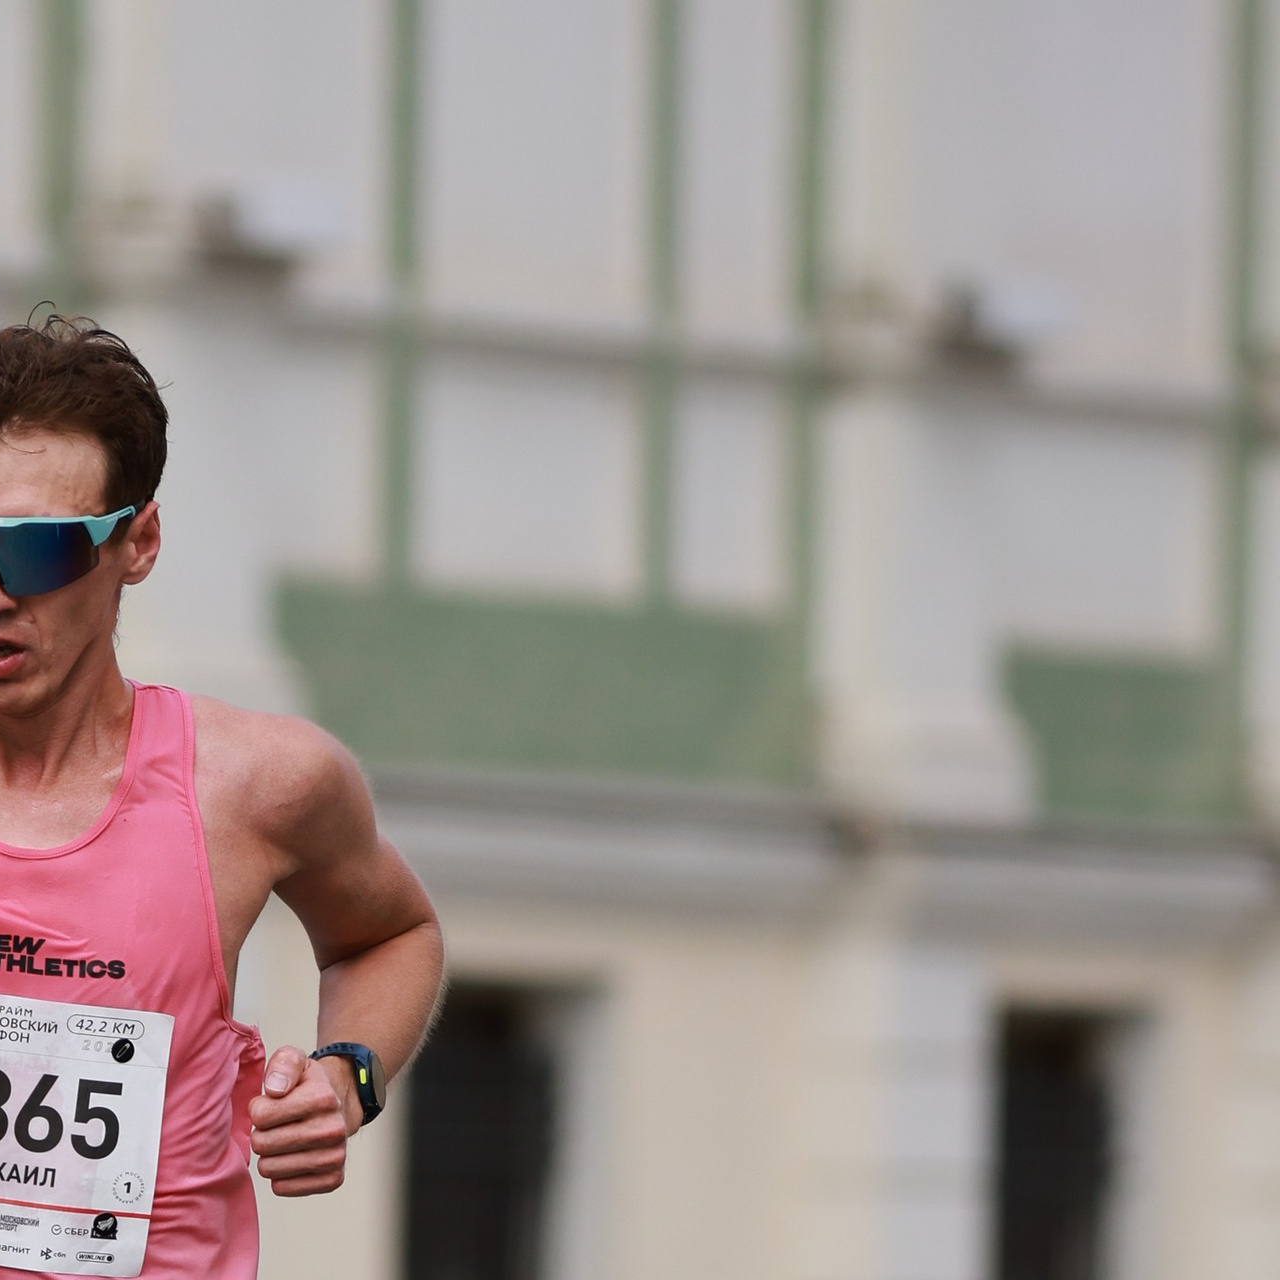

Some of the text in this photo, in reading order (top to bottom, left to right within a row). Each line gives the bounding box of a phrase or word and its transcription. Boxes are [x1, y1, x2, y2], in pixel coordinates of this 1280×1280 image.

[75, 1018, 108, 1034] 42,2
[82, 1039, 114, 1054] 202
[123, 1181, 131, 1194] 1
[64, 1227, 89, 1236] СБЕР
